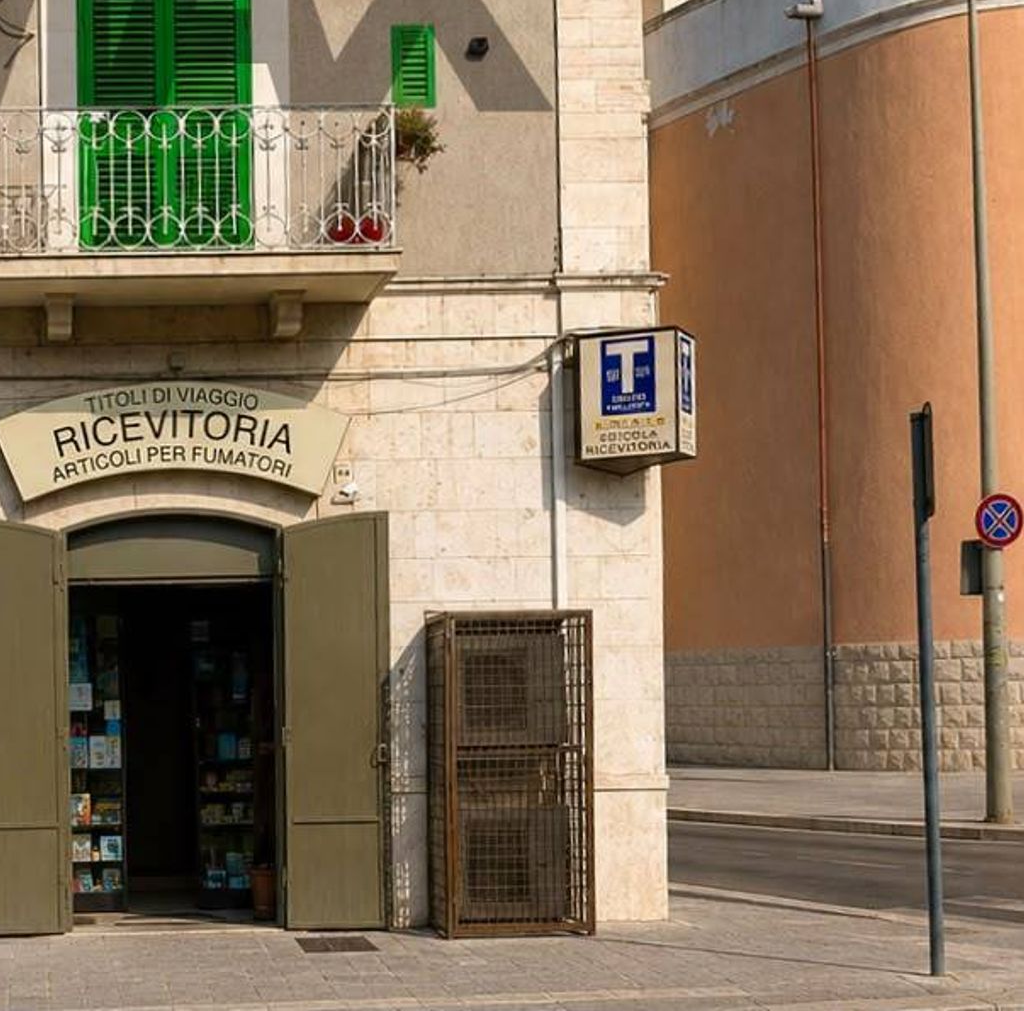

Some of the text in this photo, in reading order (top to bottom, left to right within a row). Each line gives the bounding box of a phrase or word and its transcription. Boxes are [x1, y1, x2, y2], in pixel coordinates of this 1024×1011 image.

[605, 339, 649, 394] T
[84, 387, 259, 414] TITOLI DI VIAGGIO
[53, 409, 292, 458] RICEVITORIA
[52, 445, 292, 484] ARTICOLI PER FUMATORI
